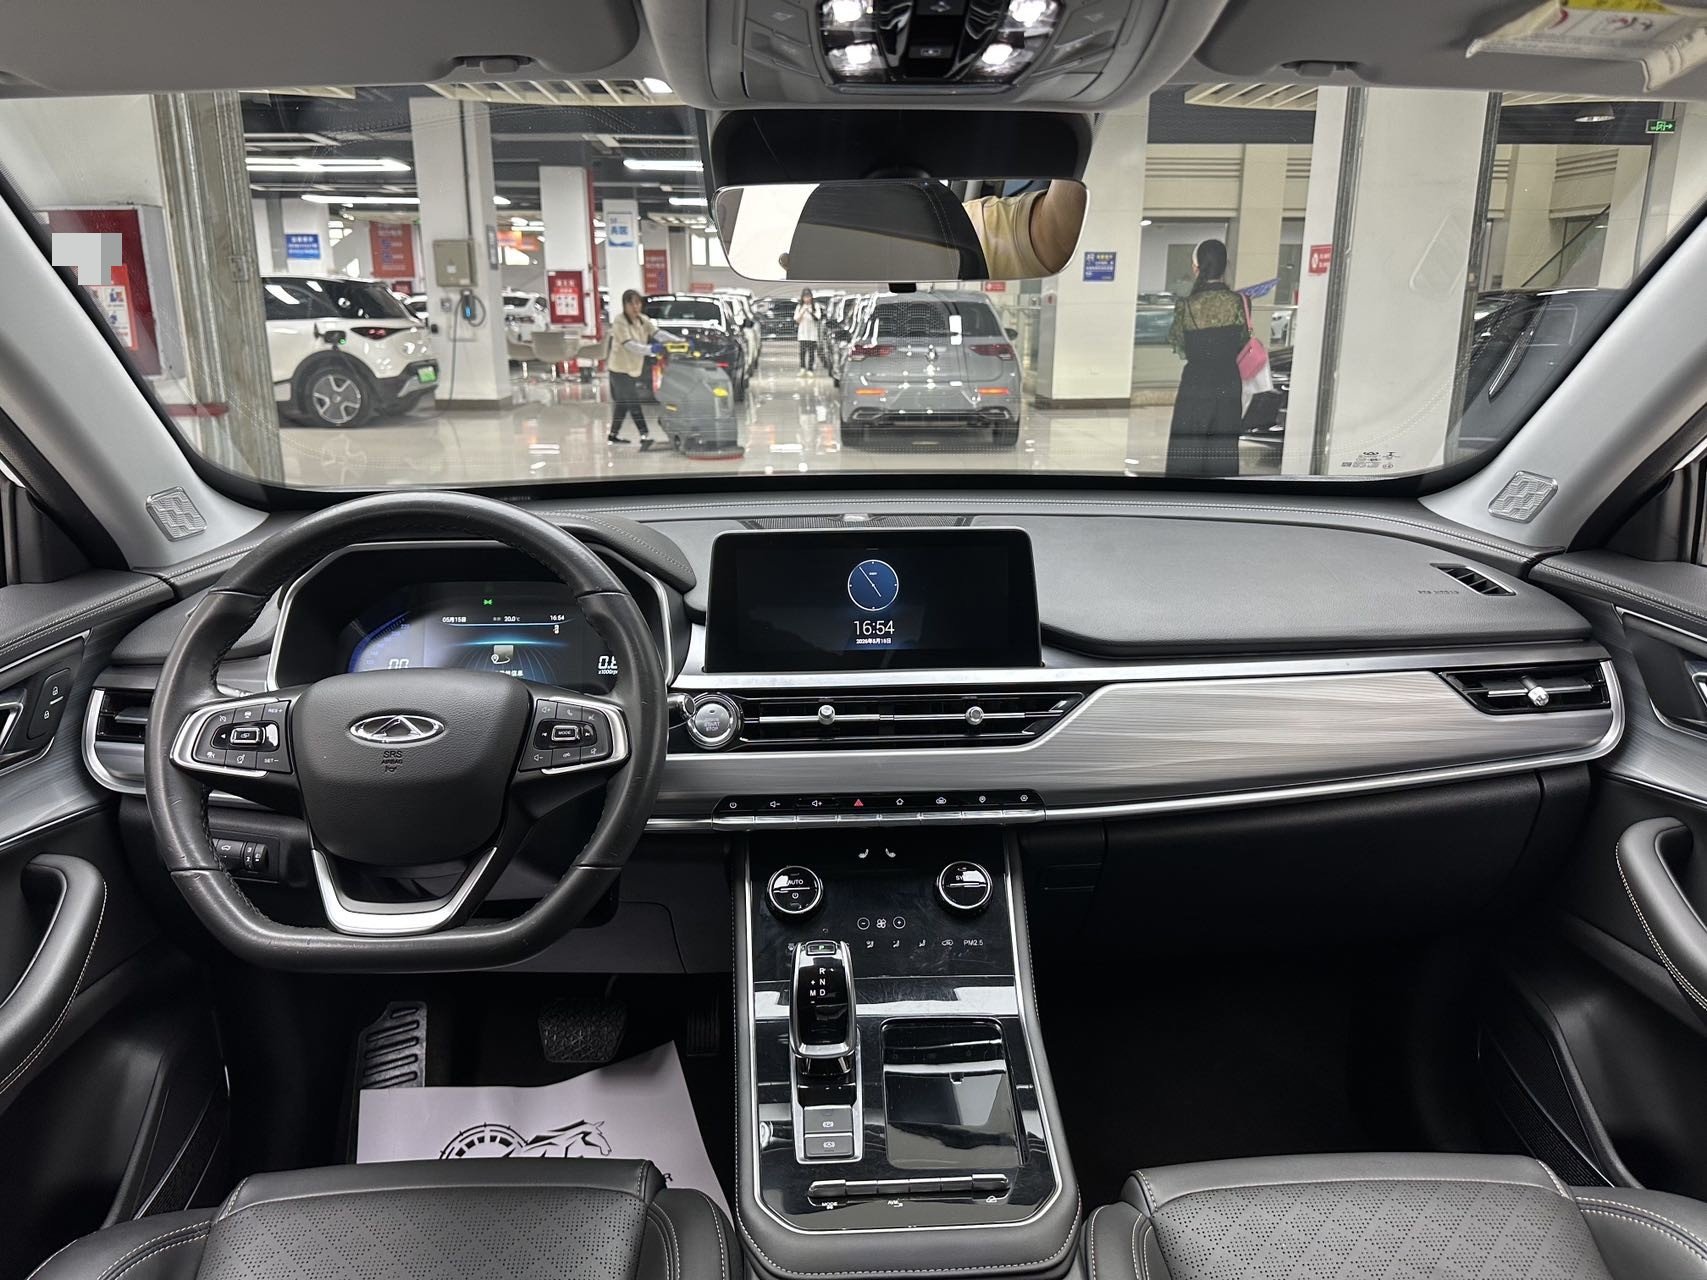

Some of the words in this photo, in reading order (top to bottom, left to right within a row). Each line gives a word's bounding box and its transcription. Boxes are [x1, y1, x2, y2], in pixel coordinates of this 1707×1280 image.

[853, 620, 895, 635] 16:54
[383, 750, 403, 758] SRS
[819, 967, 826, 975] R
[809, 989, 817, 997] M
